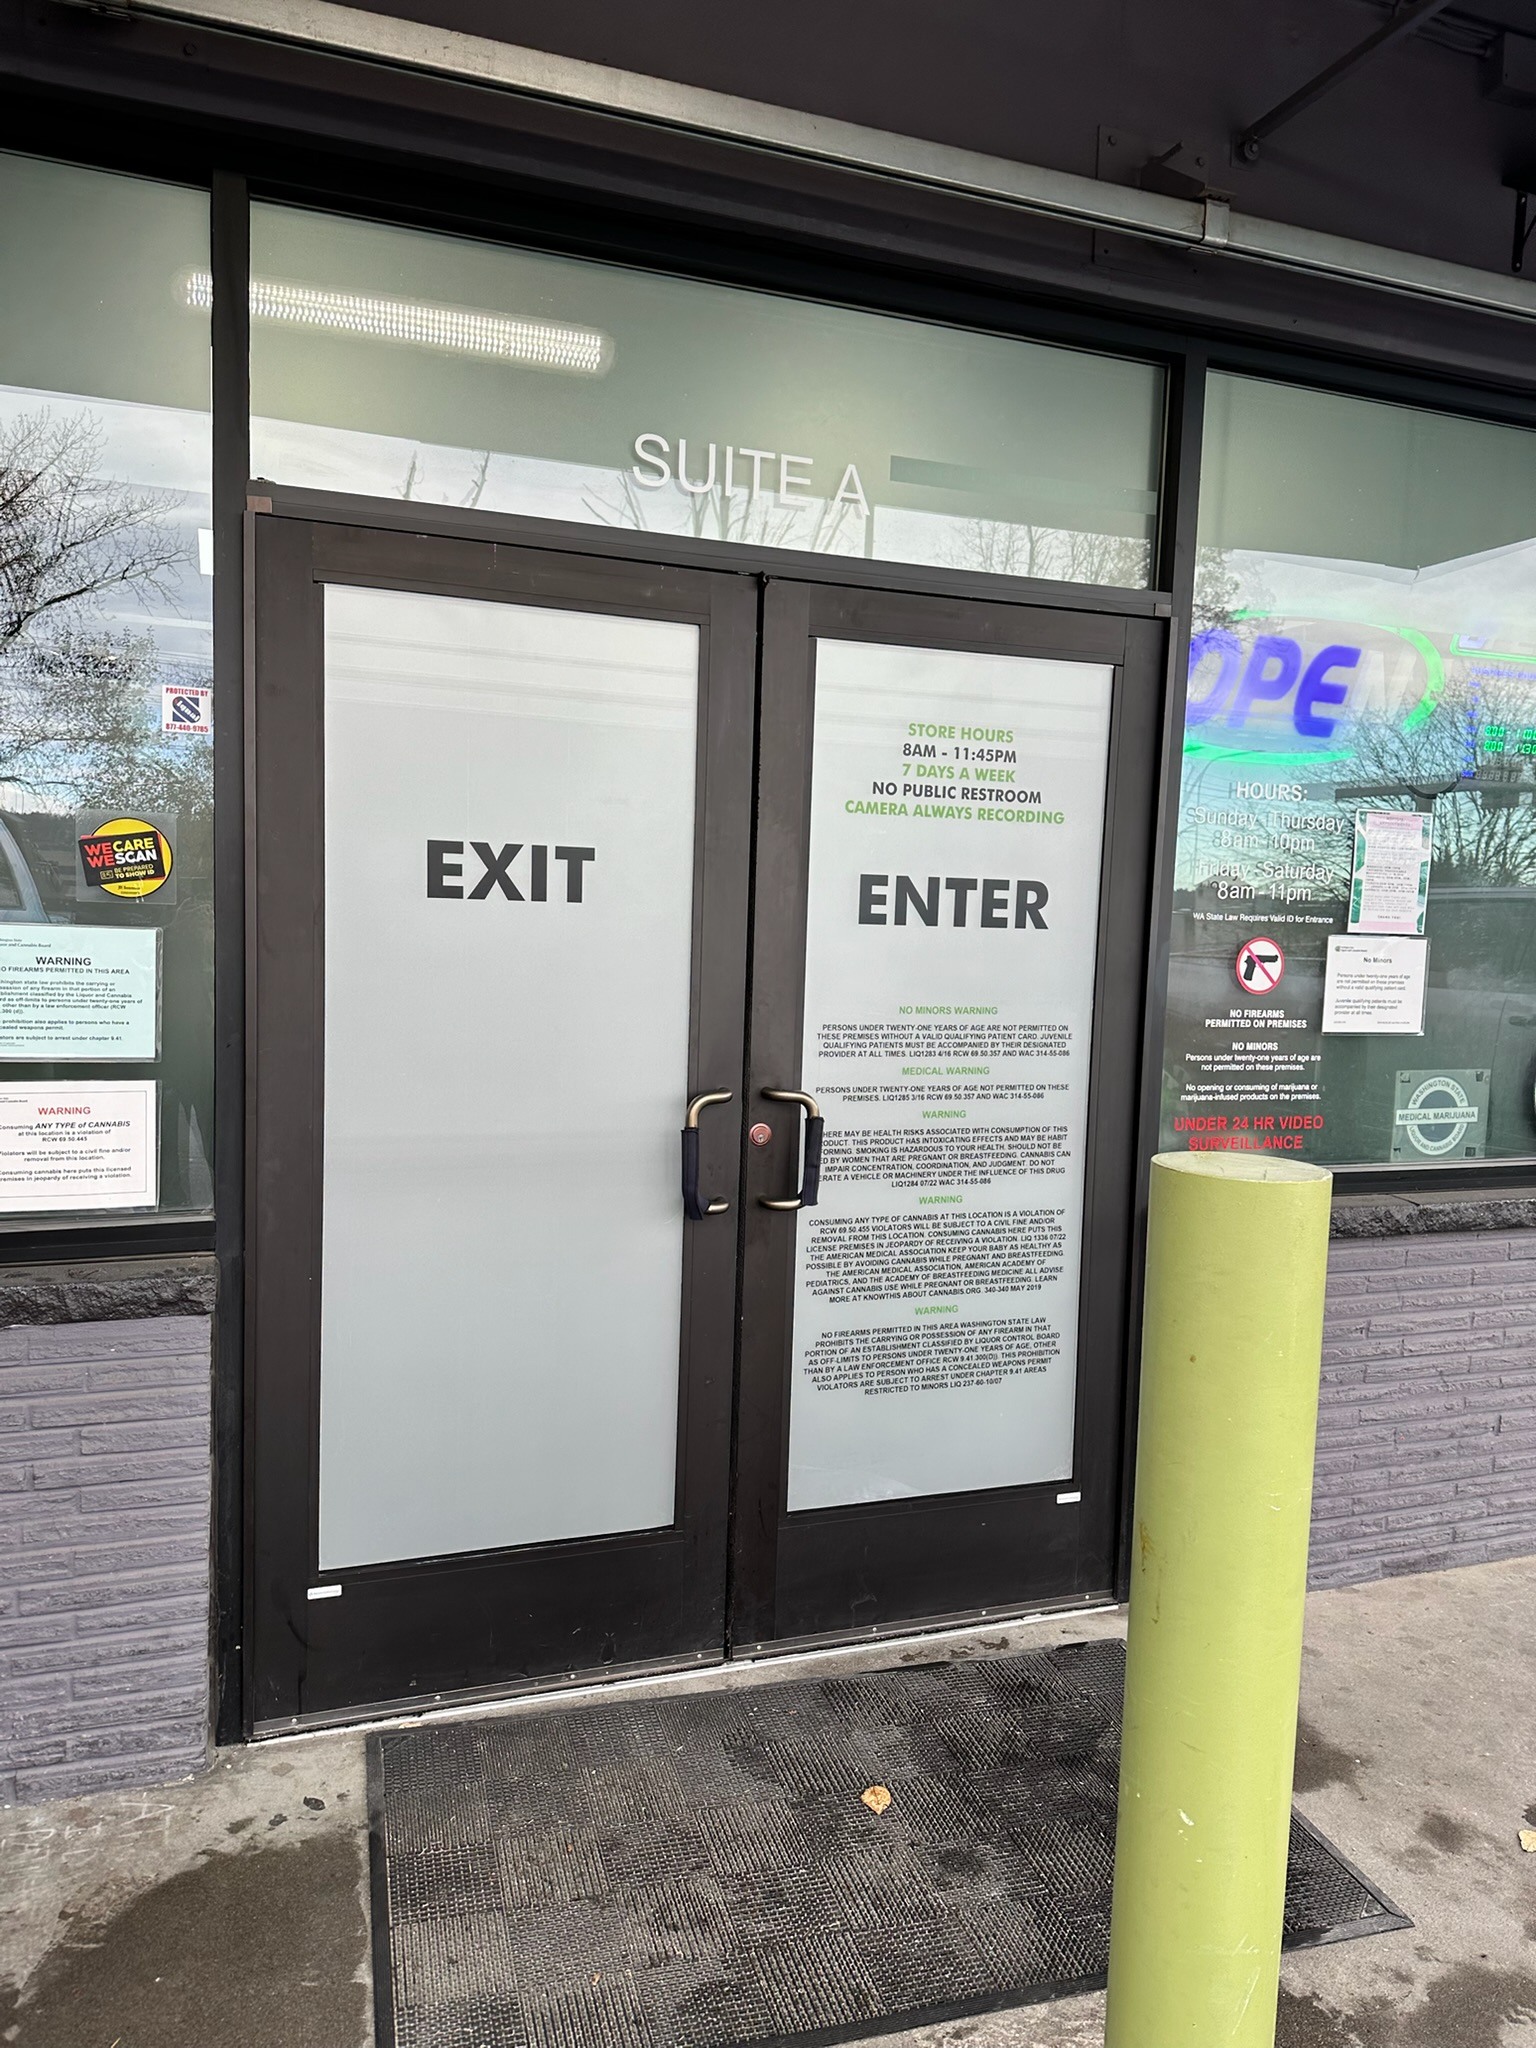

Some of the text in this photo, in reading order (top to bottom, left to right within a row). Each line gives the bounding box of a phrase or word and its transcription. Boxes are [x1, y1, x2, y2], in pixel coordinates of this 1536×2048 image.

[633, 433, 870, 516] SUITE A
[165, 687, 200, 696] PROTECTED
[908, 723, 1014, 743] STORE HOURS
[902, 743, 935, 759] 8AM
[954, 746, 1017, 763] 11:45PM
[902, 763, 1016, 783] 7 DAYS A WEEK
[872, 782, 1042, 804] NO PUBLIC RESTROOM
[1236, 781, 1308, 801] HOURS:
[845, 800, 1065, 824] CAMERA ALWAYS RECORDING
[1194, 806, 1344, 834] Sunday Thursday
[84, 837, 155, 856] WE CARE
[86, 849, 158, 868] WE SCAN
[123, 863, 154, 871] PREPARED
[427, 840, 595, 903] EXIT
[1199, 860, 1335, 884] Friday Saturday
[125, 870, 147, 878] SHOW
[1217, 881, 1255, 900] 8am
[1269, 883, 1311, 904] 11pm
[858, 873, 1049, 930] ENTER
[1239, 914, 1268, 923] Requires
[1305, 916, 1333, 924] Entrance
[35, 956, 92, 966] WARNING
[899, 1006, 998, 1015] NO MINORS WARNING
[1229, 1009, 1285, 1018] NO FIREARMS
[1205, 1019, 1307, 1028] PERMITTED ON PREMISES
[823, 1042, 867, 1050] QUALIFYING
[1232, 1042, 1278, 1051] NO MINORS
[1234, 1054, 1269, 1063] twenty-one
[902, 1067, 990, 1076] MEDICAL WARNING
[1213, 1064, 1244, 1072] permitted
[1274, 1064, 1305, 1072] premises.
[1196, 1084, 1224, 1093] opening
[1233, 1084, 1269, 1092] consuming
[1278, 1084, 1309, 1092] marijuana
[1411, 1079, 1466, 1105] WASHINGTON STATE
[1181, 1093, 1238, 1102] marijuana-infused
[1239, 1093, 1268, 1102] products
[1290, 1093, 1321, 1102] premises.
[38, 1106, 91, 1115] WARNING
[922, 1110, 967, 1119] WARNING
[1398, 1111, 1476, 1121] MEDICAL MARIJUANA
[1174, 1115, 1324, 1131] UNDER 24 HR VIDEO
[1188, 1135, 1304, 1151] SURVEILLANCE
[919, 1195, 963, 1205] WARNING
[915, 1305, 959, 1316] WARNING
[833, 1329, 870, 1338] FIREARMS
[872, 1326, 912, 1335] PERMITTED
[939, 1323, 958, 1331] AREA
[960, 1320, 1006, 1329] WASHINGTON
[1007, 1318, 1028, 1326] STATE
